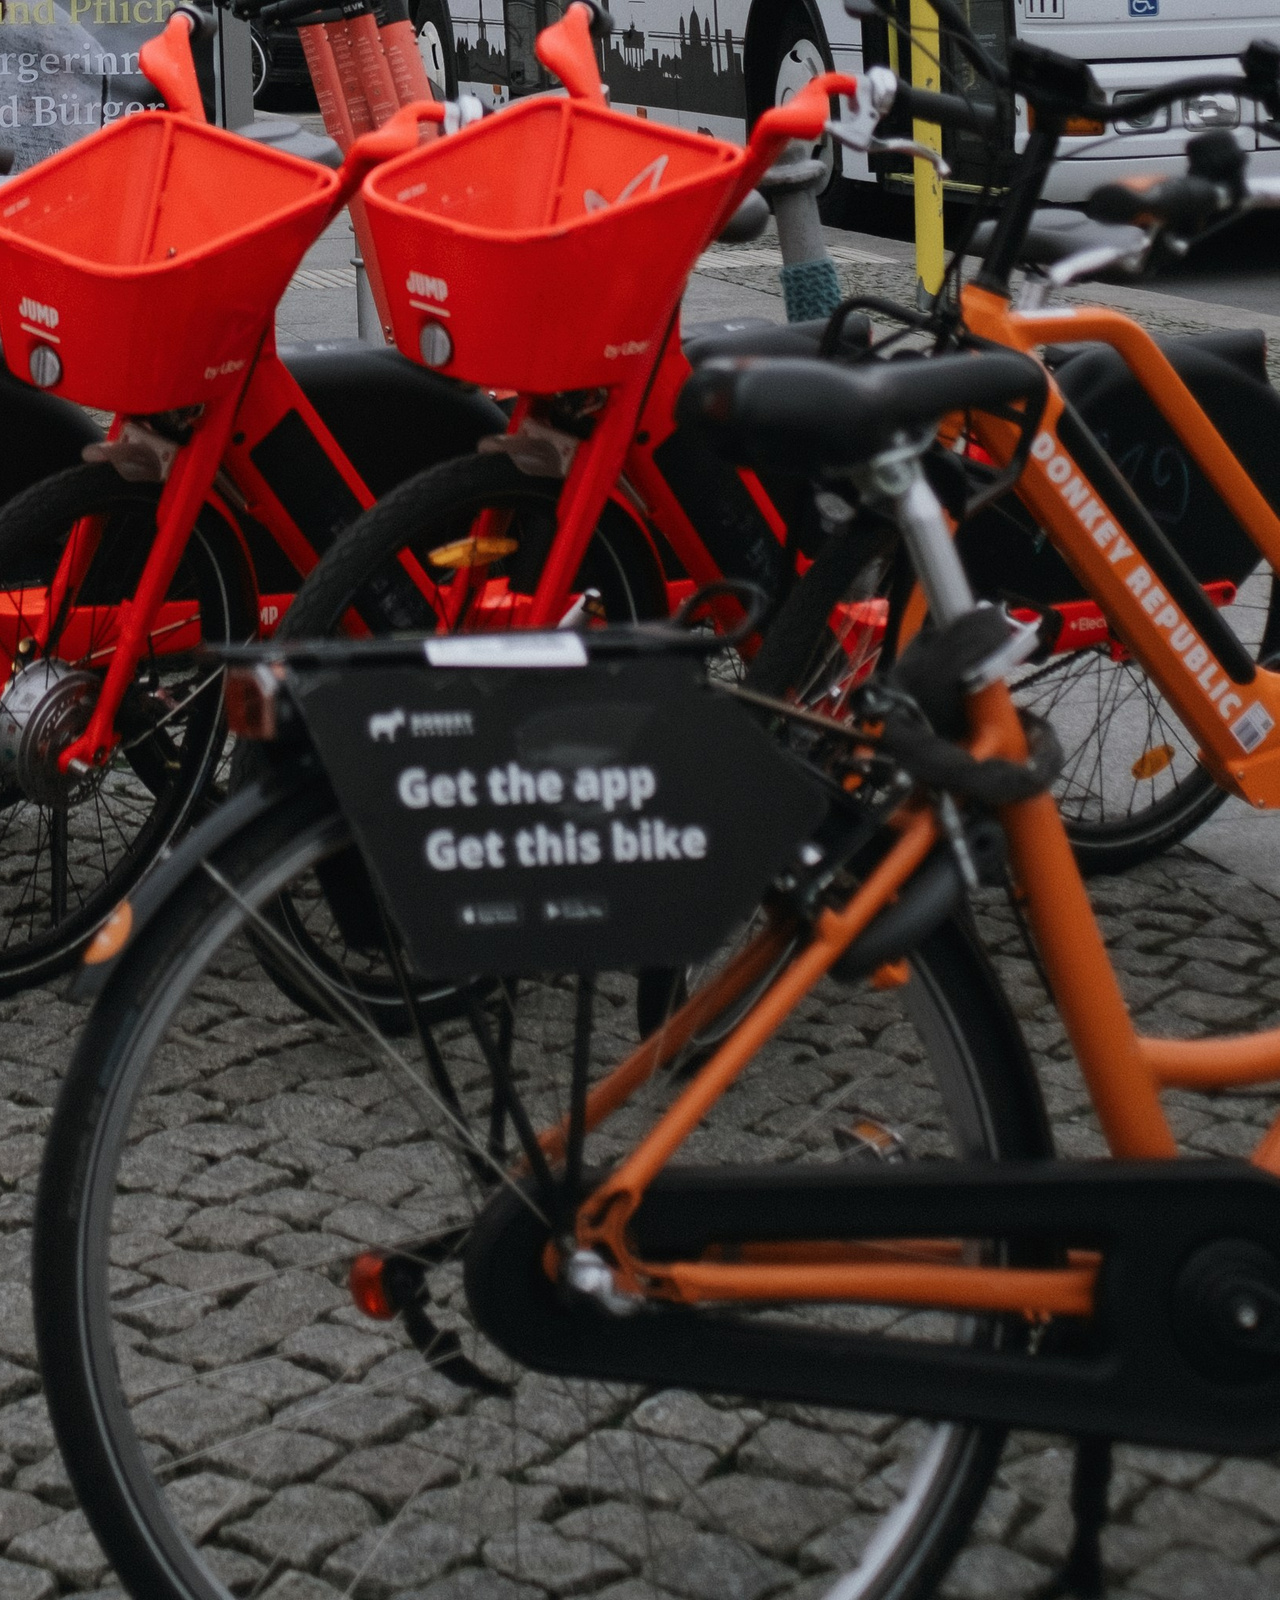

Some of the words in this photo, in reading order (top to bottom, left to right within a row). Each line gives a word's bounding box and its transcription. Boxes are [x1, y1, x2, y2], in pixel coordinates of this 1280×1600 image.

[18, 296, 59, 329] JUMP
[406, 270, 449, 302] JUMP
[1030, 431, 1134, 564] DONKEY
[1124, 565, 1244, 720] REPUBLIC
[397, 764, 478, 809] Get
[486, 760, 564, 806] the
[573, 764, 657, 812] app
[425, 828, 506, 872] Get
[514, 820, 602, 868] this
[610, 817, 708, 863] bike
